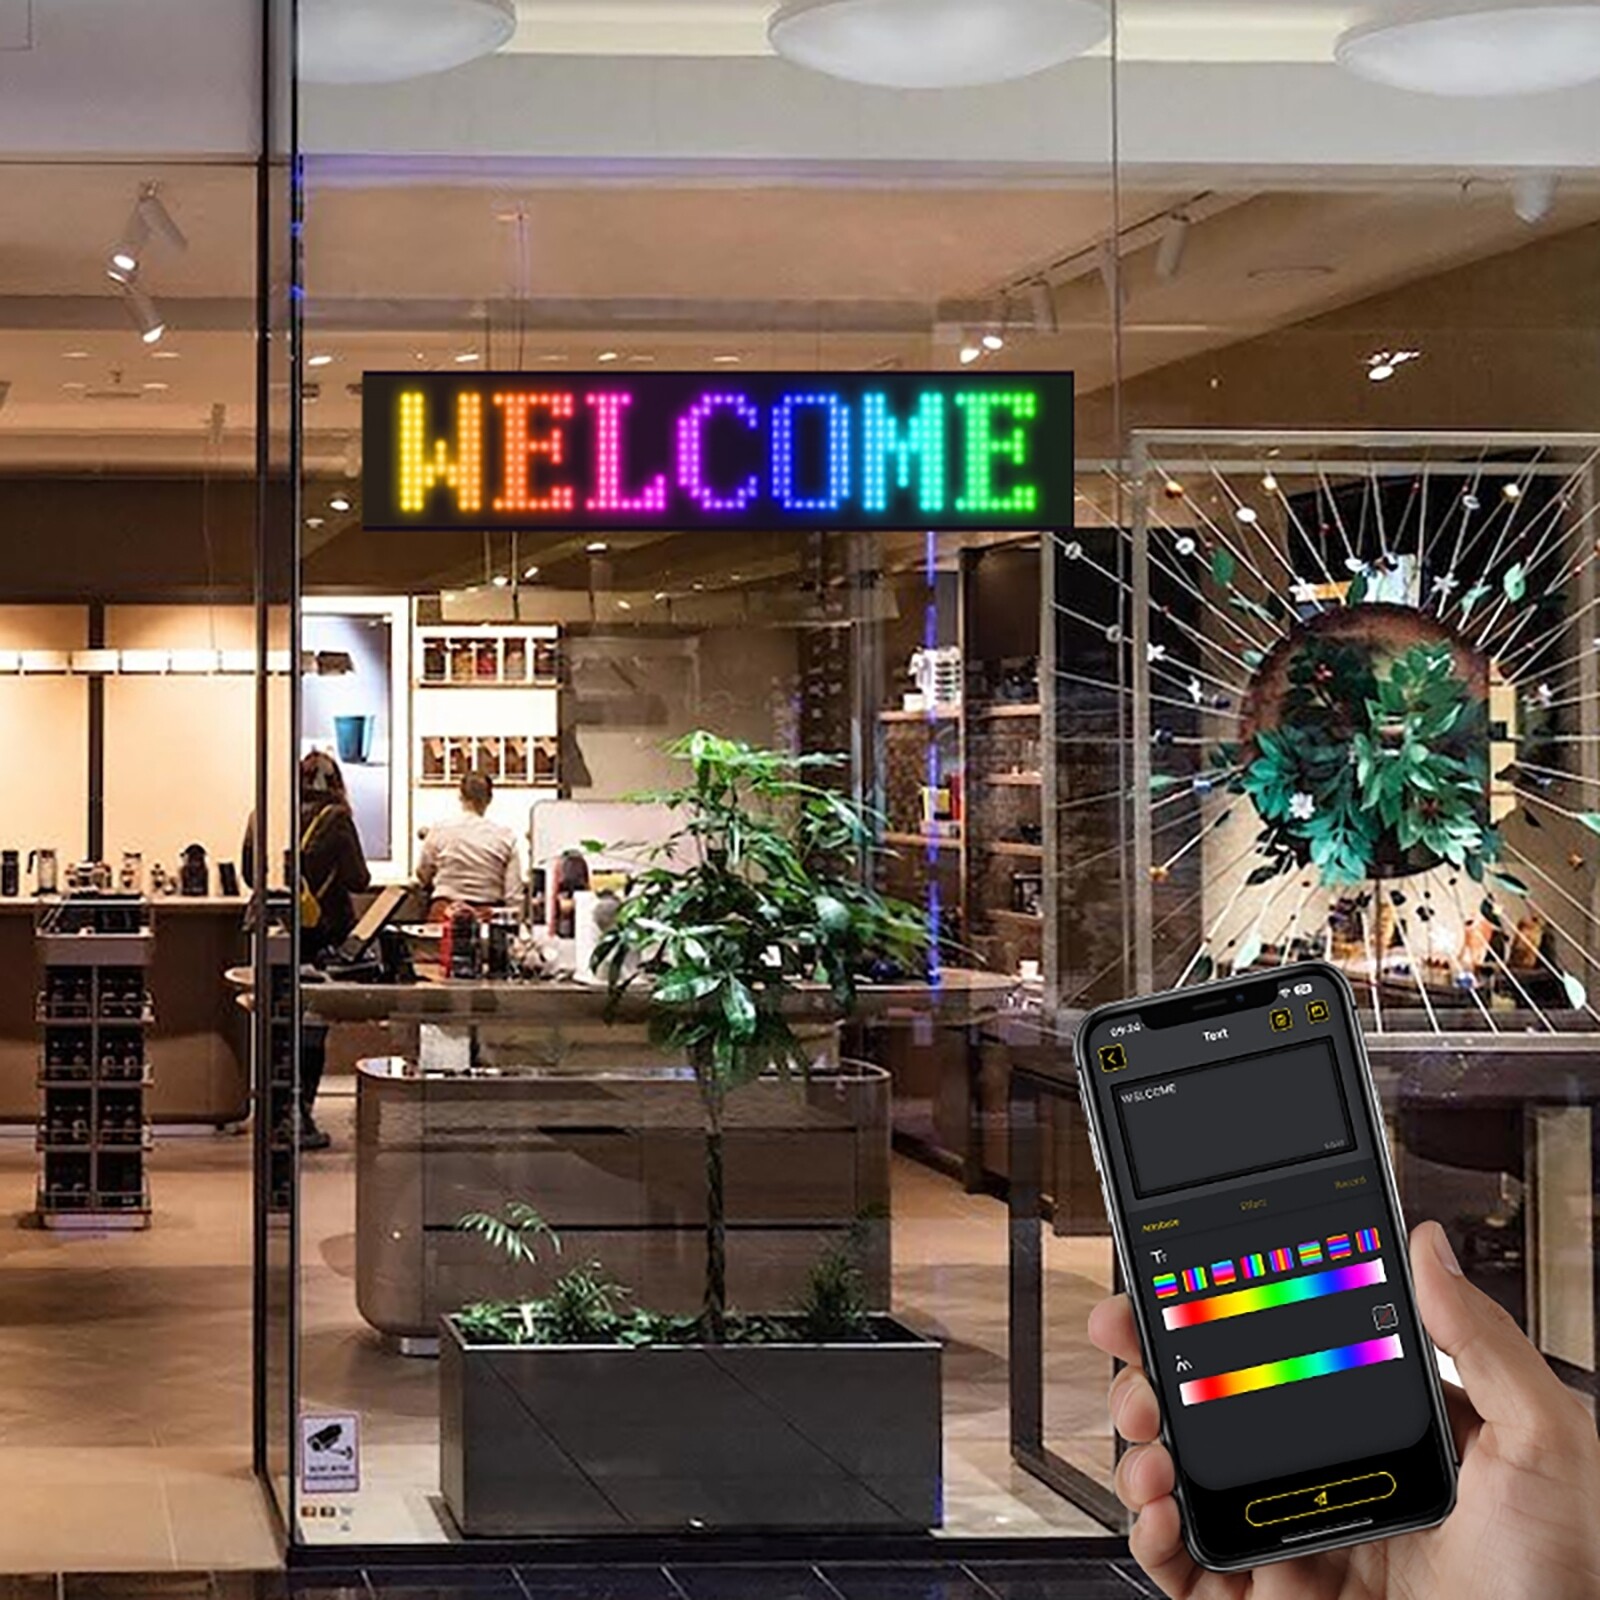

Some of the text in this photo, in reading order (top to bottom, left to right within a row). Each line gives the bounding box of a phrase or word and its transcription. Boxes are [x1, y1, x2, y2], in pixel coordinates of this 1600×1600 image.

[397, 392, 1037, 512] WELCOME
[1202, 1028, 1229, 1042] Text
[1120, 1083, 1177, 1103] WELCOME
